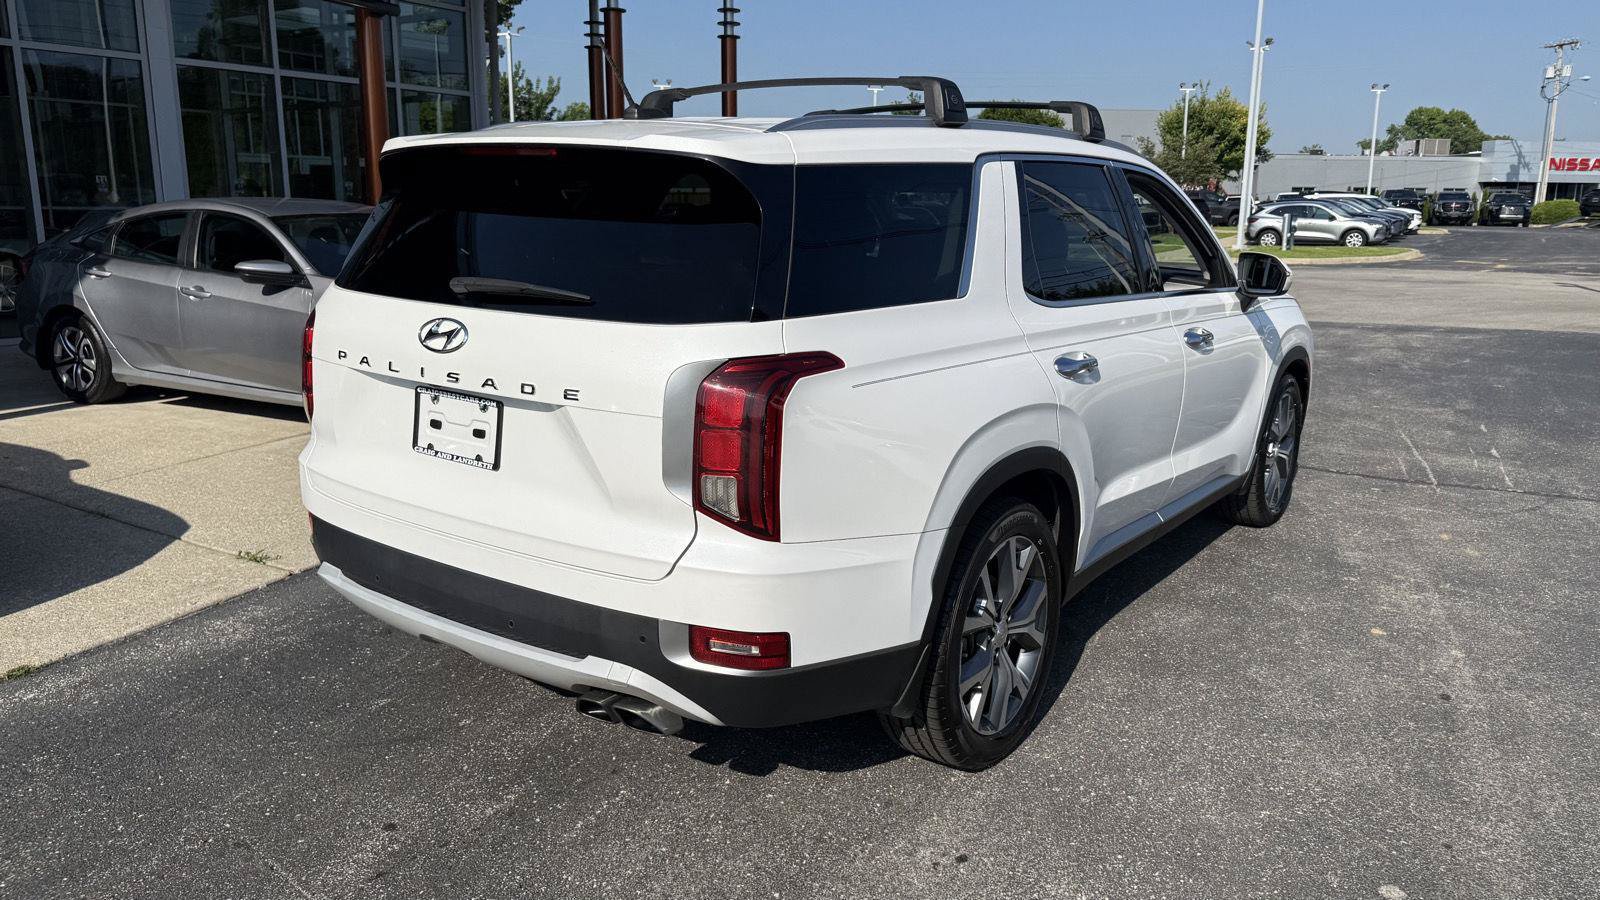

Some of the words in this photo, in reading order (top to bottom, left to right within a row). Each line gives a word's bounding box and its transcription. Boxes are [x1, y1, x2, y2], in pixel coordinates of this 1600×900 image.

[338, 350, 580, 401] PALISADE
[415, 446, 436, 456] CRAIG
[437, 450, 452, 460] AND
[453, 455, 493, 470] LANDRETH
